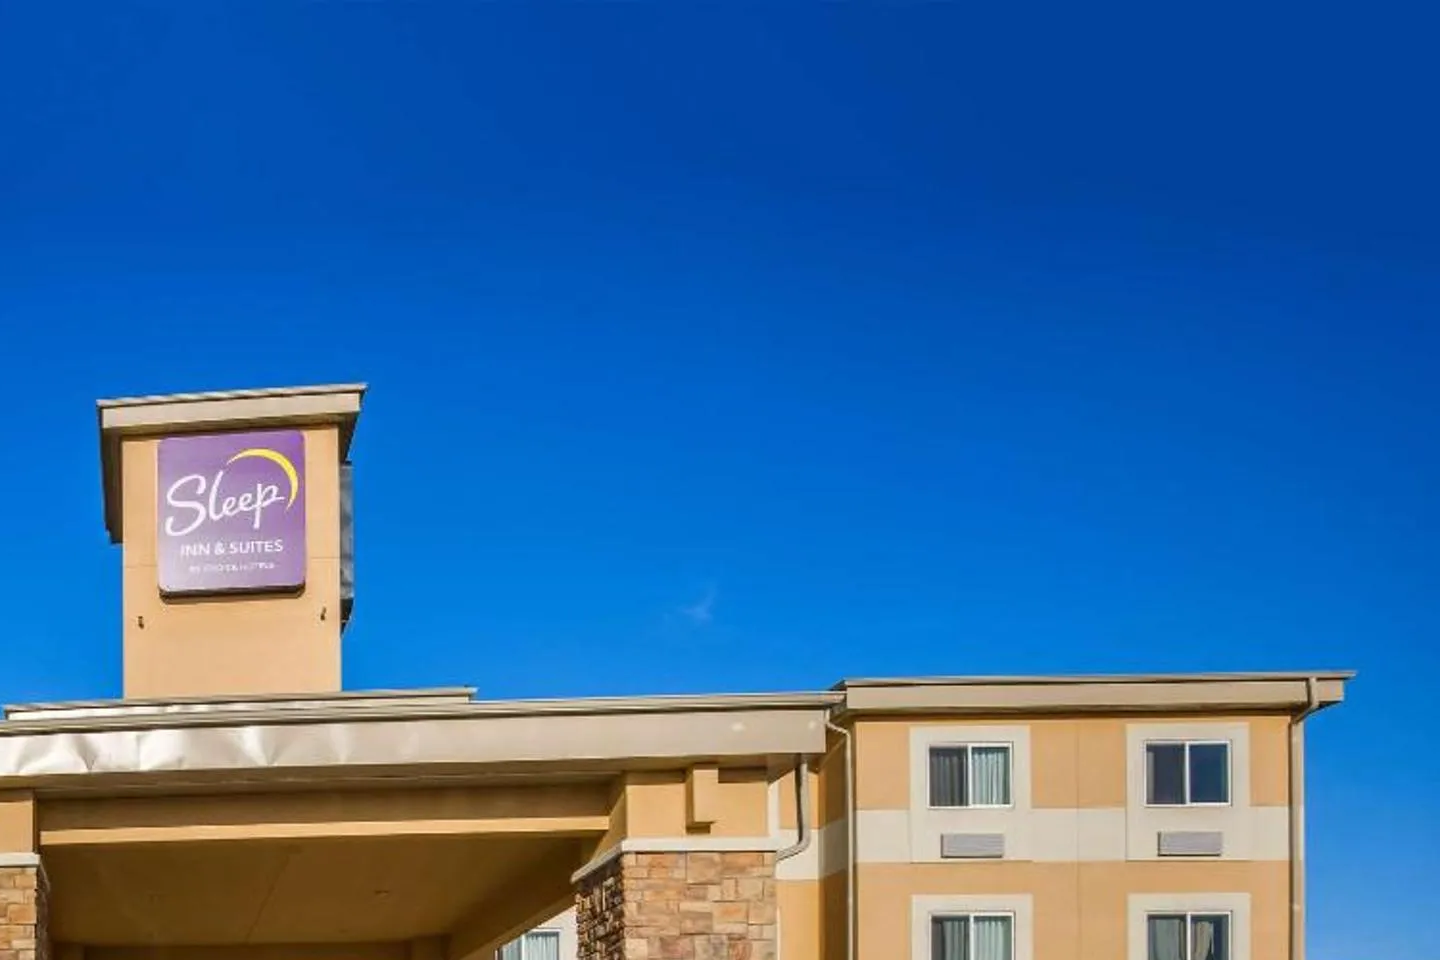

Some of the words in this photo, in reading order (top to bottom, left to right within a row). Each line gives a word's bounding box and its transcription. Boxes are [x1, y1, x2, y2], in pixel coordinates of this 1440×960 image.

[164, 470, 285, 537] Sleep
[180, 543, 210, 556] INN
[214, 541, 225, 556] &
[229, 539, 284, 554] SUITES
